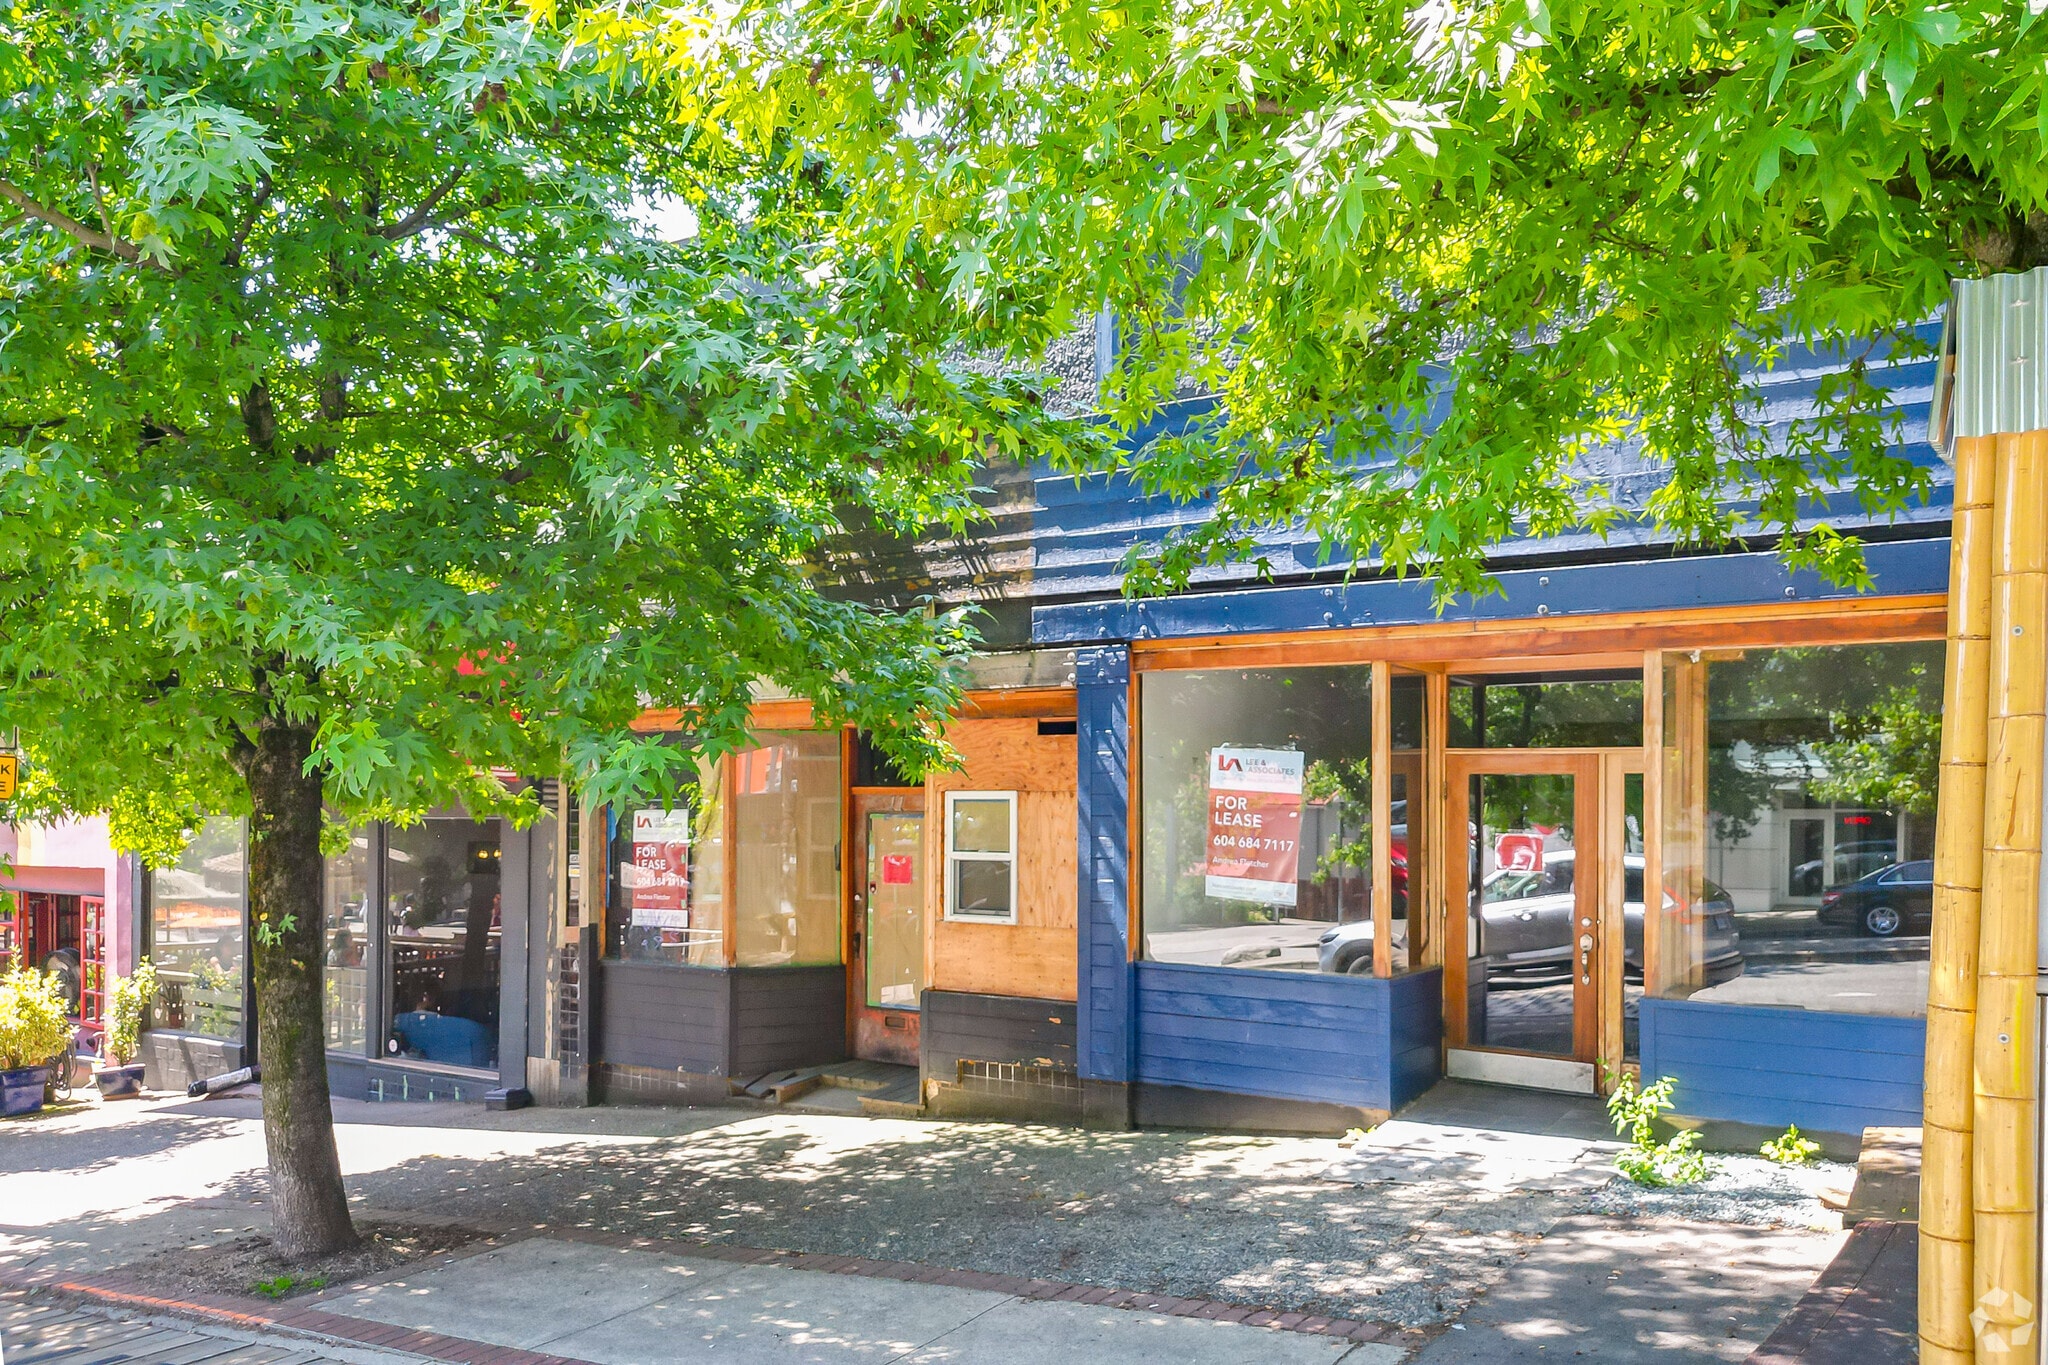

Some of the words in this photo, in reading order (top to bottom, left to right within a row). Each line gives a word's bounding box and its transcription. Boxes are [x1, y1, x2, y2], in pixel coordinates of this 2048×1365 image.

[1245, 758, 1258, 766] LEE
[1247, 766, 1295, 776] ASSOCIATES
[1215, 795, 1247, 811] FOR
[1214, 811, 1262, 828] LEASE
[1213, 834, 1236, 847] 604
[1238, 836, 1261, 849] 684
[1263, 838, 1294, 852] 7117
[635, 846, 657, 858] FOR
[635, 859, 666, 870] LEASE
